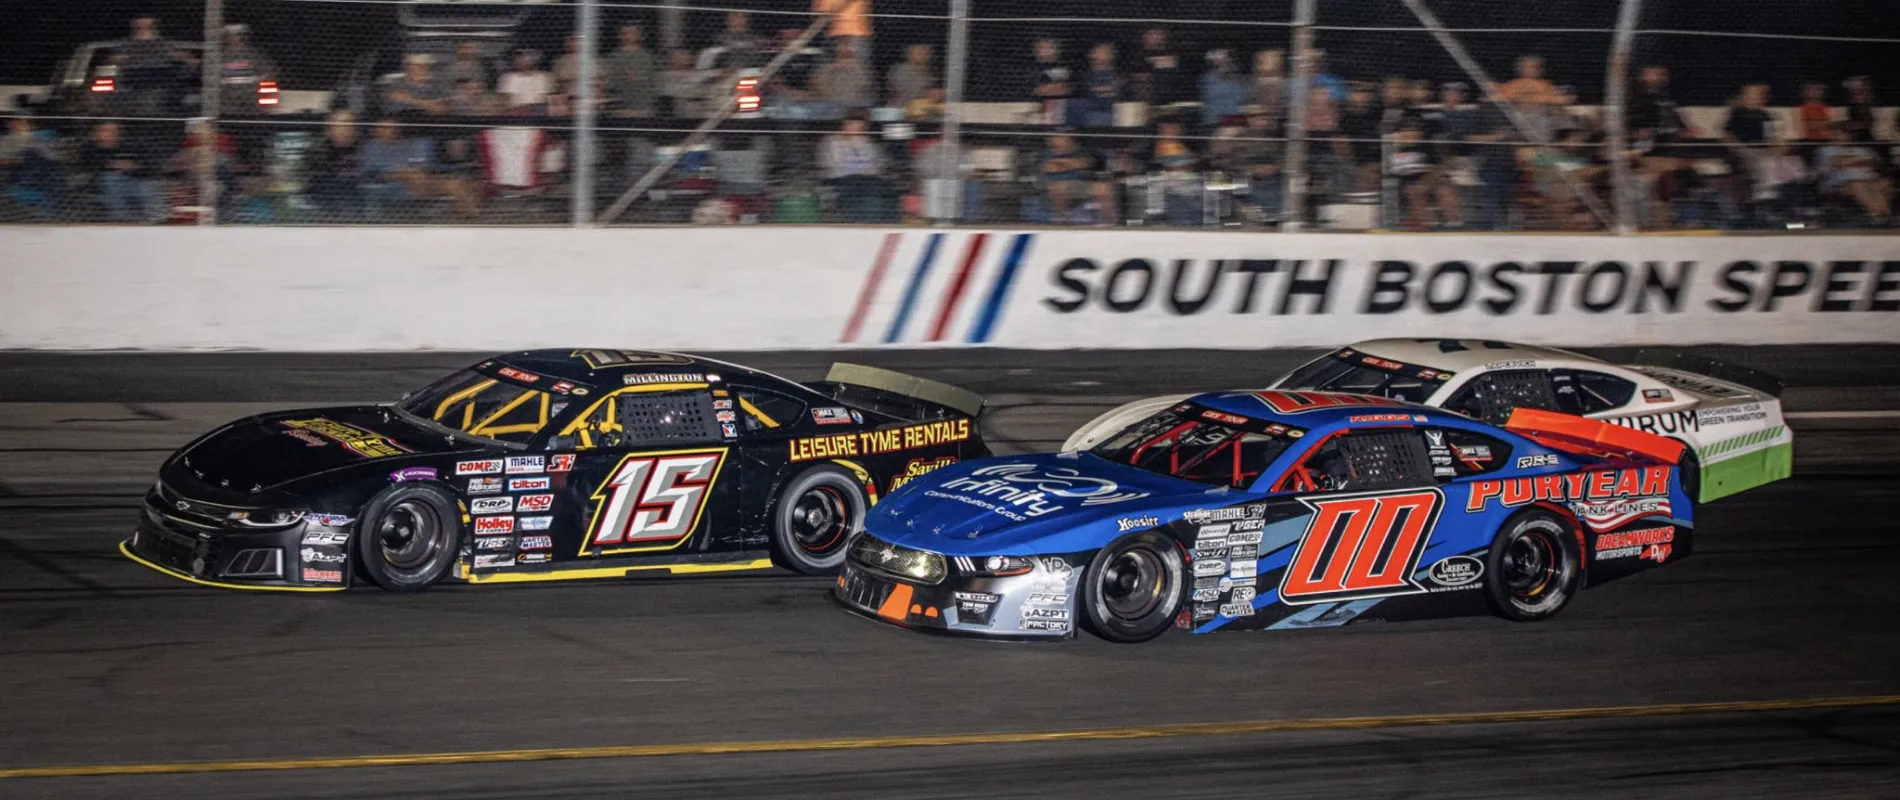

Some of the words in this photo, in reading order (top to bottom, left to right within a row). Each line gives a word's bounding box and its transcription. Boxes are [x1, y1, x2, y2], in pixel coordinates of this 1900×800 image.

[1042, 258, 1341, 316] SOUTH
[1359, 260, 1694, 317] BOSTON
[1706, 260, 1900, 313] SPEE
[622, 373, 704, 385] MILLINGTON
[1700, 406, 1741, 417] EMPOWERING
[1743, 404, 1761, 412] YOUR
[1700, 417, 1725, 426] GREEN
[1727, 412, 1767, 423] TRANSITION
[790, 435, 857, 460] LEISURE
[861, 427, 901, 453] TYME
[904, 419, 968, 448] RENTALS
[459, 461, 493, 472] COMP
[511, 457, 544, 466] MAHLE
[906, 459, 956, 477] Savill
[511, 480, 547, 488] tilton
[1465, 466, 1671, 513] PURYEAR
[520, 496, 552, 507] MSD
[591, 453, 720, 545] 15
[940, 476, 1064, 517] Infinity
[479, 499, 507, 508] DRP
[924, 490, 996, 510] Communications
[995, 506, 1027, 521] Group
[1572, 503, 1609, 516] TANK
[1614, 502, 1658, 514] LINES
[1211, 507, 1244, 520] MAHLE
[477, 517, 513, 532] Holley
[1117, 515, 1159, 532] Hoosier
[306, 532, 348, 541] PFC
[1229, 533, 1256, 543] COMP
[1595, 526, 1675, 551] DREAMWORKS
[1197, 539, 1225, 548] tilton
[1283, 492, 1437, 598] 00
[1596, 546, 1642, 560] MOTORSPORTS
[1198, 562, 1222, 570] DRP
[1029, 593, 1068, 602] PFC
[1194, 588, 1218, 598] MSD
[1031, 609, 1068, 618] AZPT
[1027, 620, 1068, 630] FACTORY
